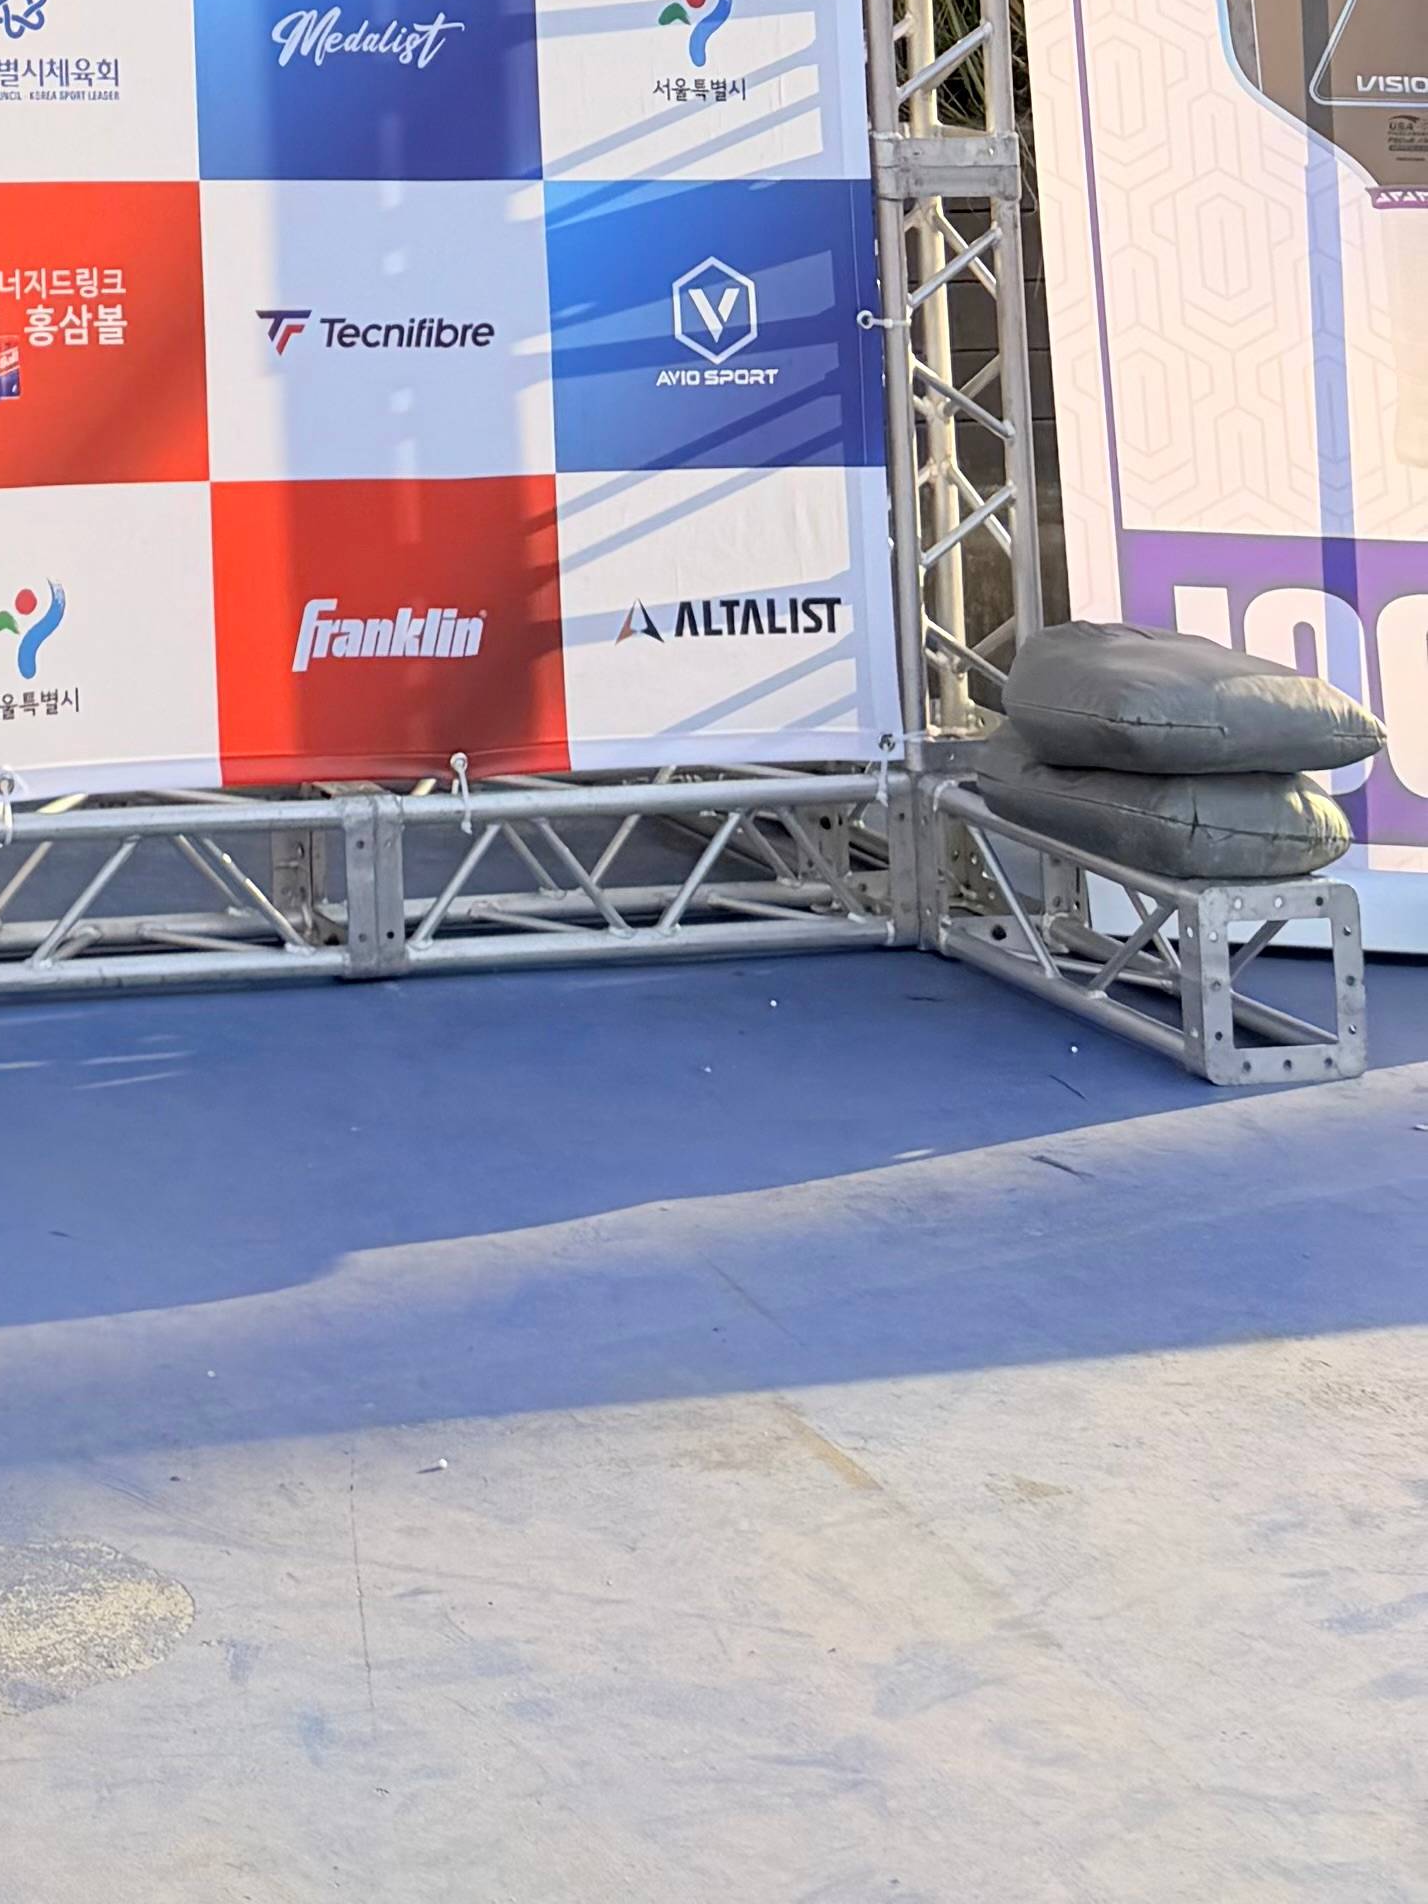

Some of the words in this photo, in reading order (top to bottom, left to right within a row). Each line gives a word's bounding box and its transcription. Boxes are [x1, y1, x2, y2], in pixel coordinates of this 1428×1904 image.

[271, 10, 466, 69] Medalist
[652, 78, 748, 102] 서울특별시
[23, 303, 128, 347] 홍삼볼
[320, 316, 495, 350] Tecnifibre
[655, 370, 699, 386] AVIO
[704, 369, 779, 385] SPORT
[291, 597, 486, 674] franklin
[674, 597, 842, 638] ALTALIST
